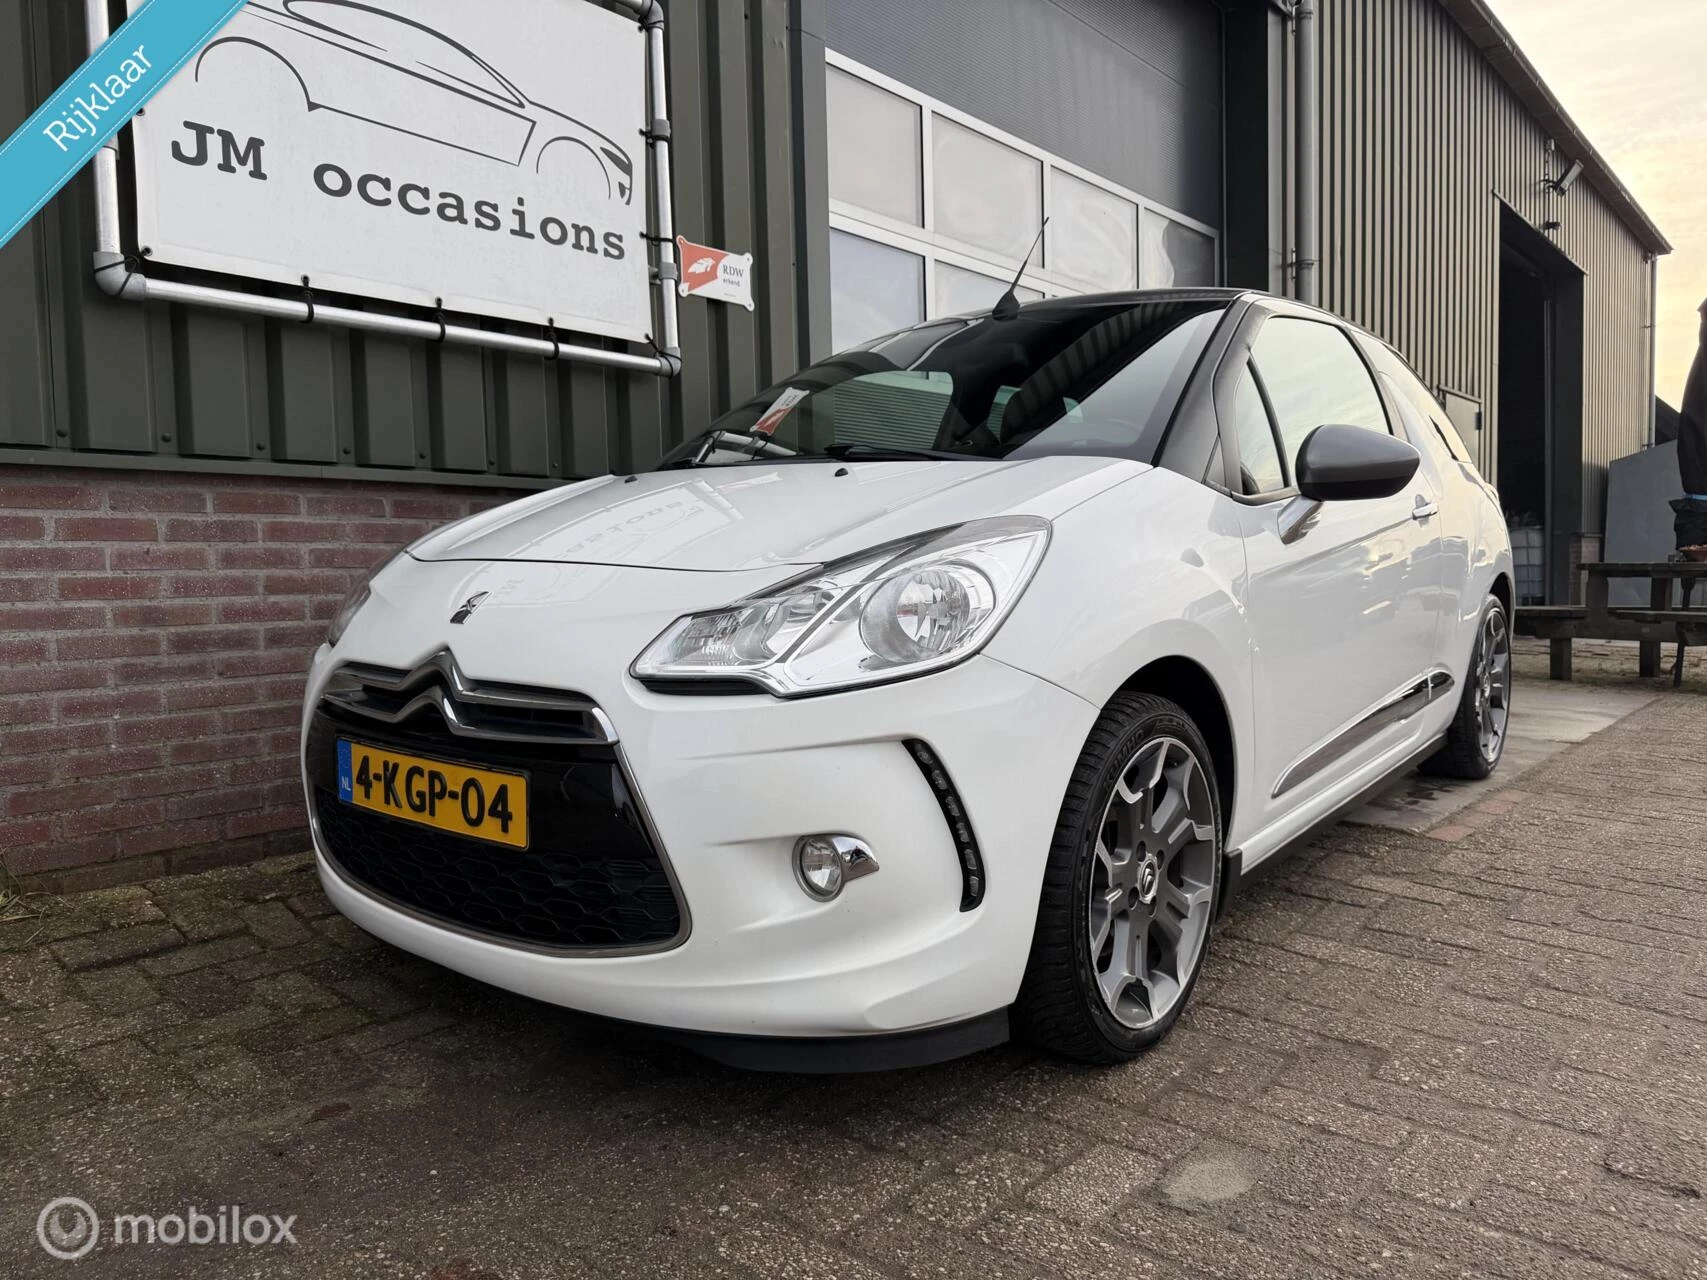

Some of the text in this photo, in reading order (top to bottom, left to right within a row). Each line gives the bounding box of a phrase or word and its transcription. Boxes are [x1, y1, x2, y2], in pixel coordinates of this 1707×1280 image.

[171, 120, 625, 260] JM occasions
[722, 264, 744, 277] RDW
[341, 776, 351, 791] NL
[356, 755, 512, 833] 4-KGP-04
